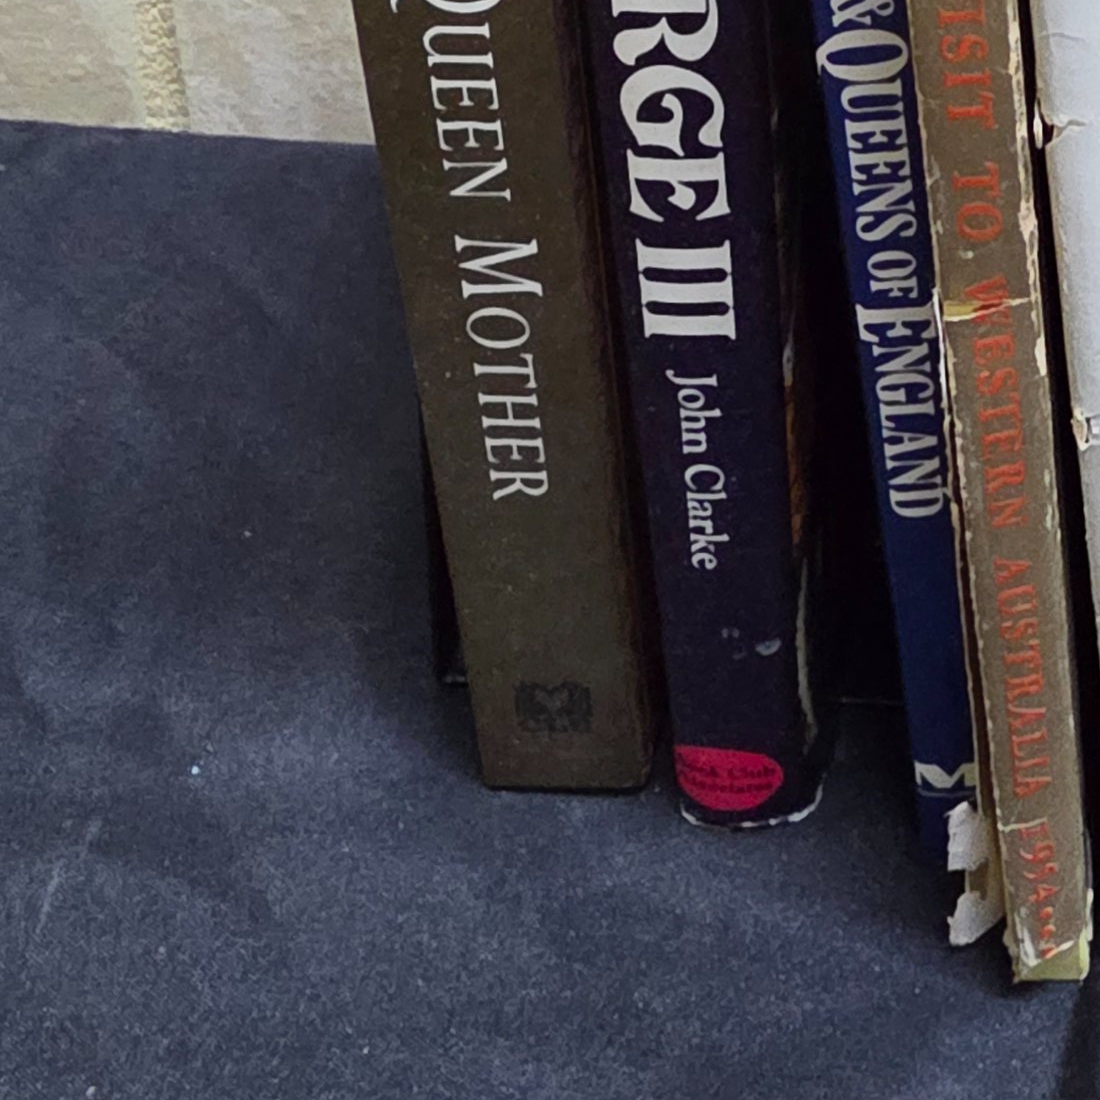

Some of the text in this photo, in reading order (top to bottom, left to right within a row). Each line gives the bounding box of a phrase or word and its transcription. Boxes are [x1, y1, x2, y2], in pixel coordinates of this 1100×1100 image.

[635, 238, 736, 340] III
[867, 251, 919, 299] OF
[952, 161, 1004, 243] TO
[455, 235, 549, 502] MOTHER
[666, 369, 730, 571] John Clarke
[857, 302, 947, 518] ENGLAND
[964, 275, 1029, 531] WESTERN
[993, 557, 1052, 800] AUSTRALIA
